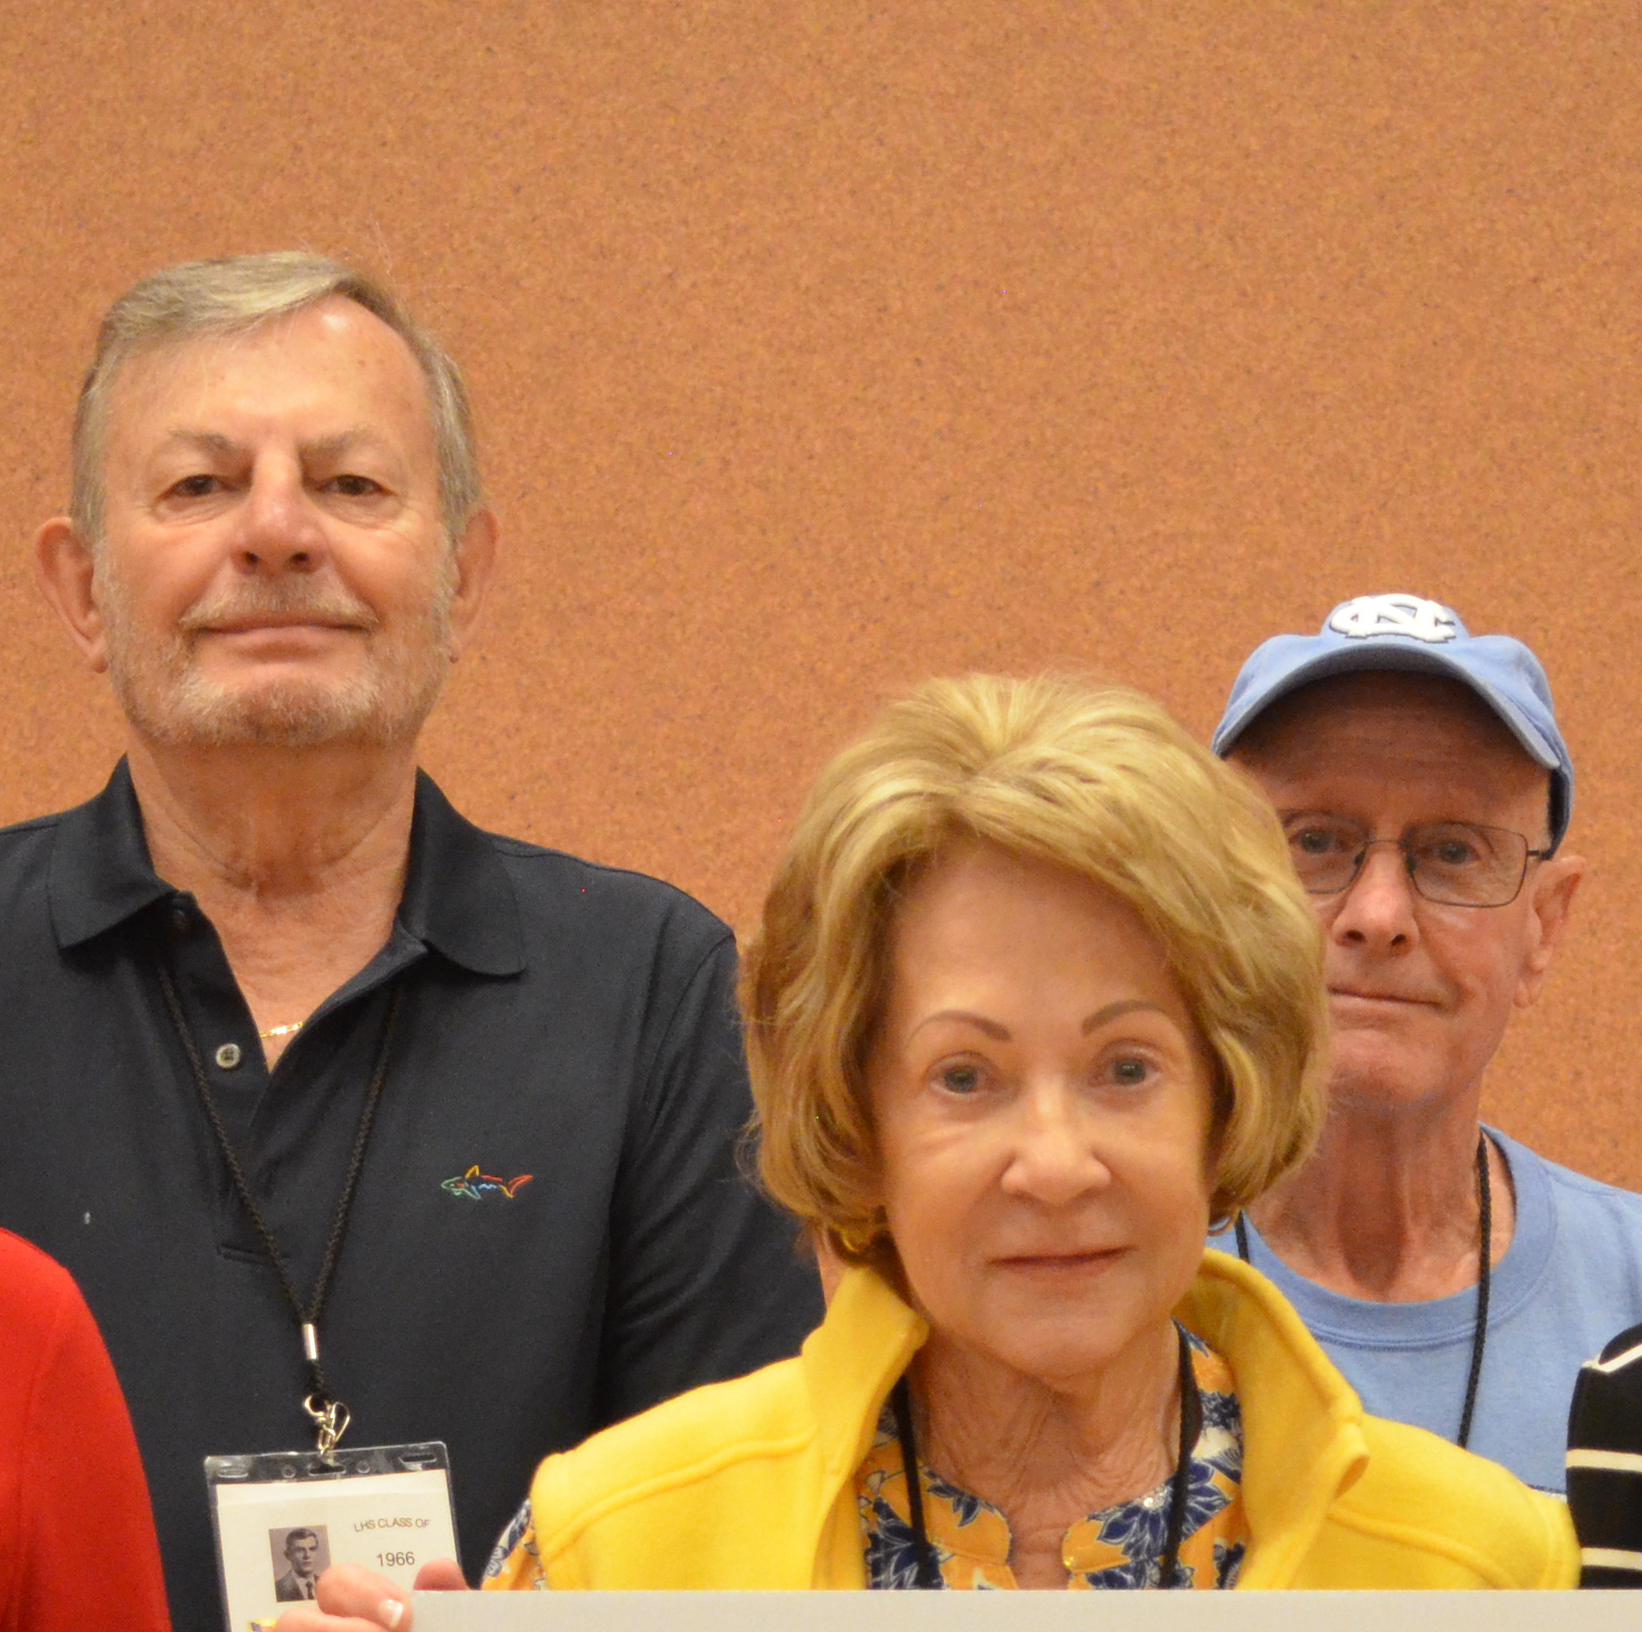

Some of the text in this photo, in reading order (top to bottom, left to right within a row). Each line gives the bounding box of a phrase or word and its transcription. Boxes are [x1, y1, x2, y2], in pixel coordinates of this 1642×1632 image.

[353, 1517, 431, 1533] LHS CLASS OF
[376, 1551, 416, 1567] 1966
